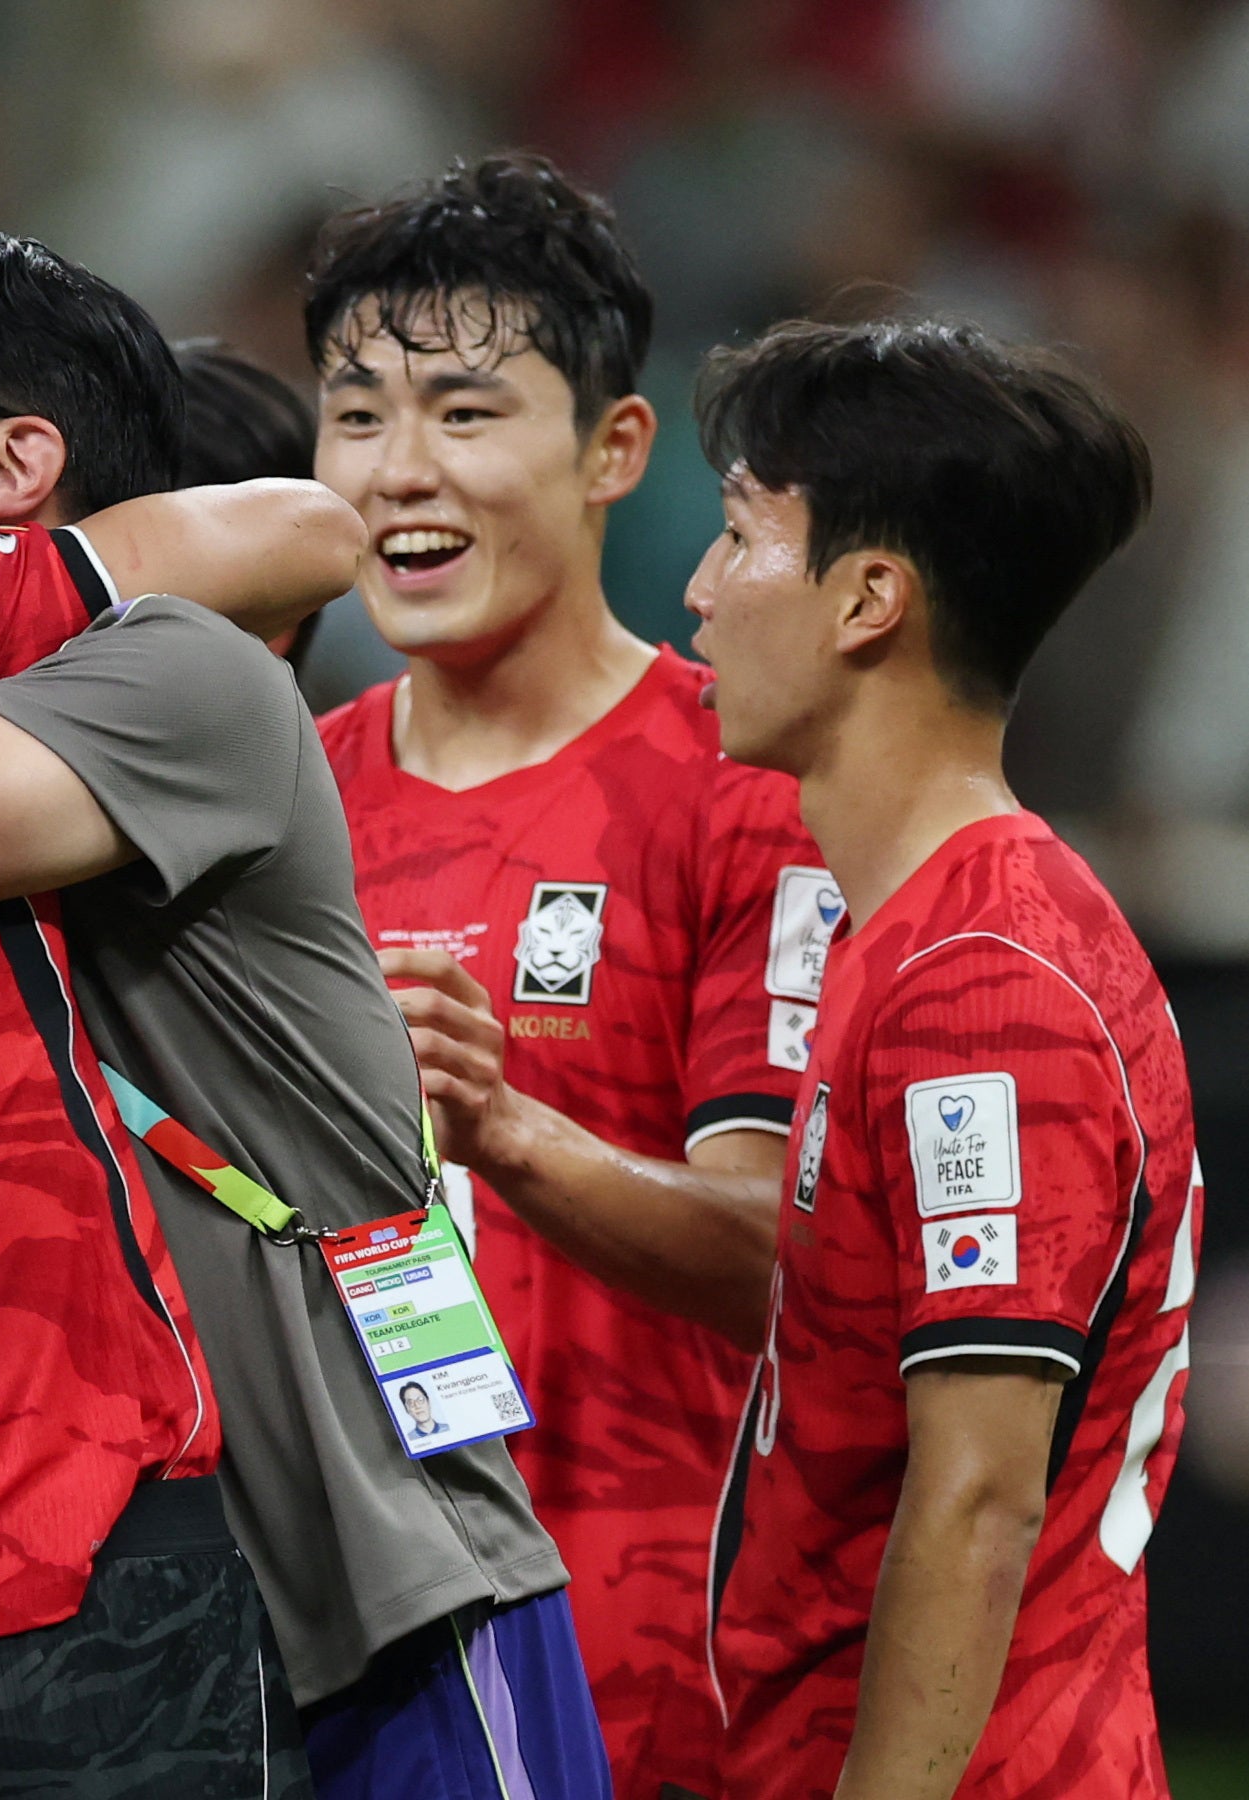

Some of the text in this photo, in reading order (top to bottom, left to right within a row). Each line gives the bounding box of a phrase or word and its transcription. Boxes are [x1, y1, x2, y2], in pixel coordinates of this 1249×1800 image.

[509, 1015, 591, 1040] KOREA
[933, 1133, 987, 1161] Unite For
[937, 1157, 985, 1184] PEACE
[946, 1184, 974, 1197] FIFA
[334, 1229, 444, 1265] FIFA WORLD CUP 2026
[365, 1255, 432, 1276] TOURNAMENT PASS
[364, 1313, 382, 1323] KOR
[392, 1305, 410, 1315] KOR
[367, 1313, 441, 1339] TEAM DELEGATE
[432, 1371, 450, 1381] KIM
